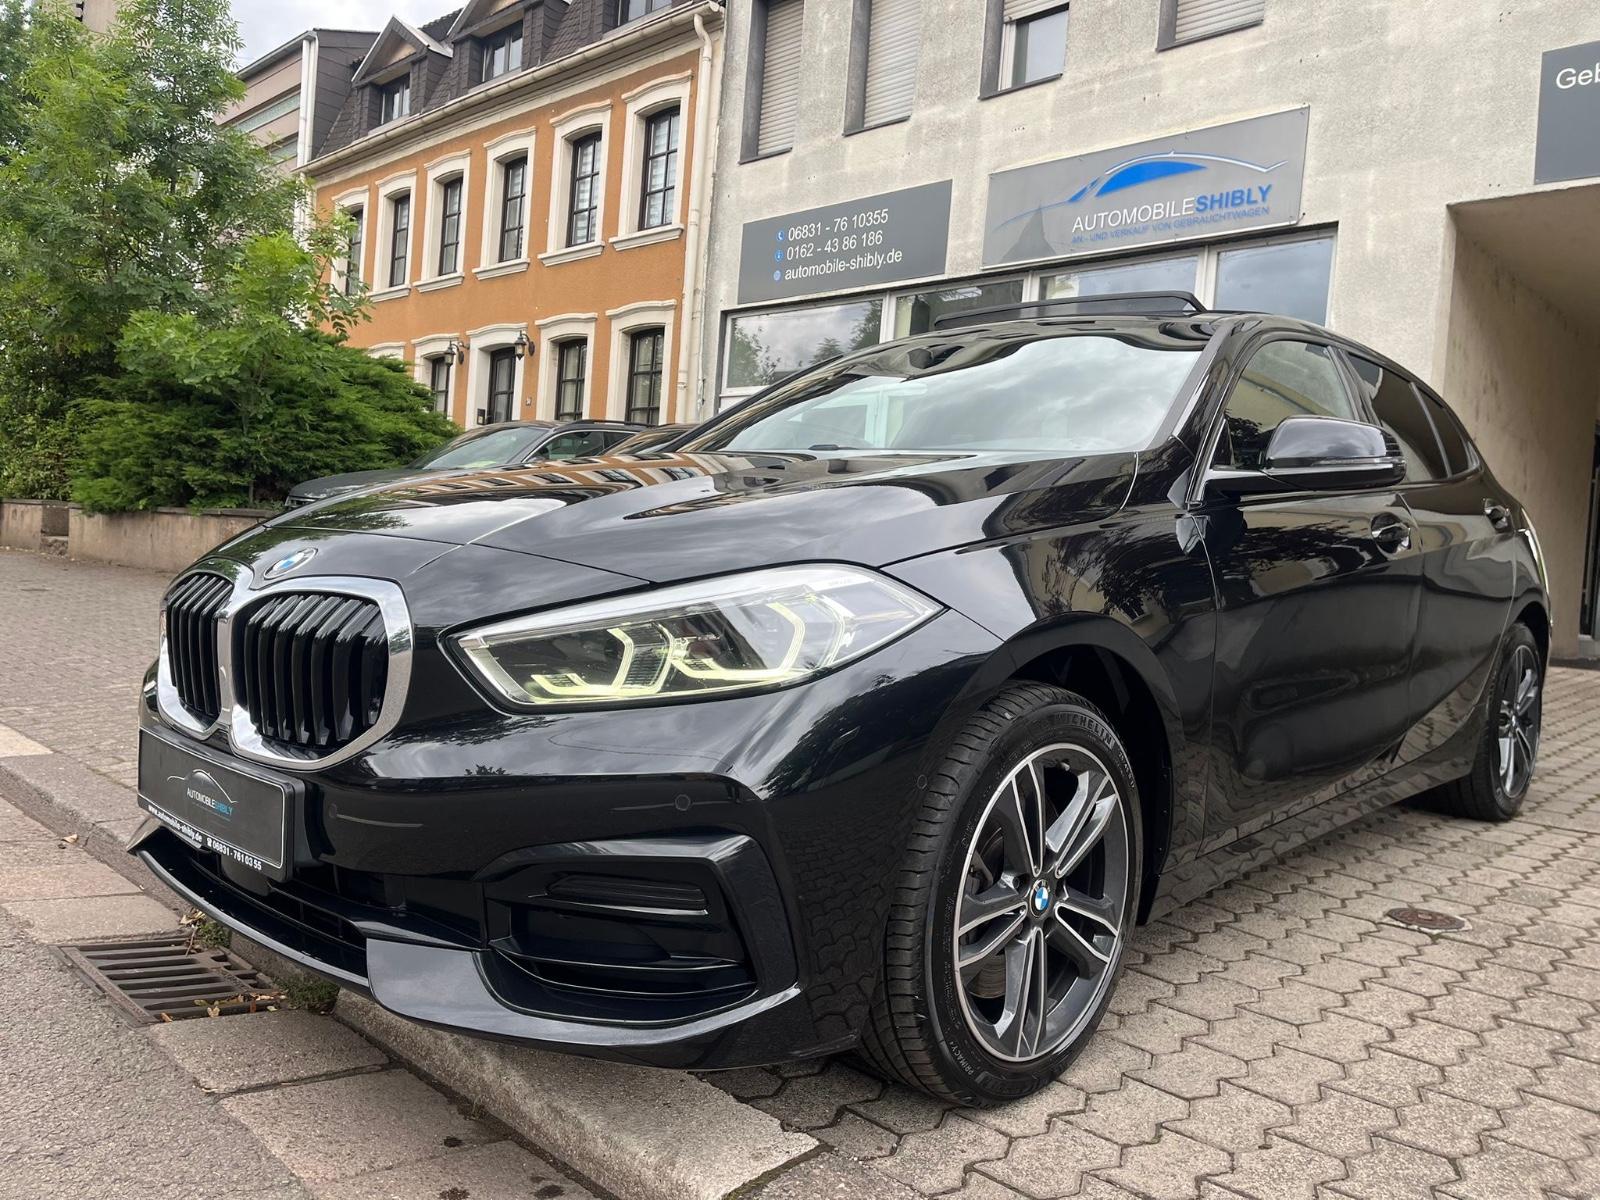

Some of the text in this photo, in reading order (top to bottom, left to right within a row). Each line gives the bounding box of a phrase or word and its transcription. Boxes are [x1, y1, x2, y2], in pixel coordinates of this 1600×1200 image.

[788, 222, 822, 241] 06831
[834, 217, 848, 233] 76
[852, 208, 889, 229] 10355
[1152, 219, 1171, 232] VON
[1174, 207, 1270, 229] GEBRAUCHTWAGEN
[787, 243, 814, 261] 0162
[824, 238, 839, 253] 43
[842, 235, 857, 250] 86
[861, 230, 883, 247] 186
[784, 248, 903, 280] automobile-shibly.de
[212, 840, 230, 856] 06831
